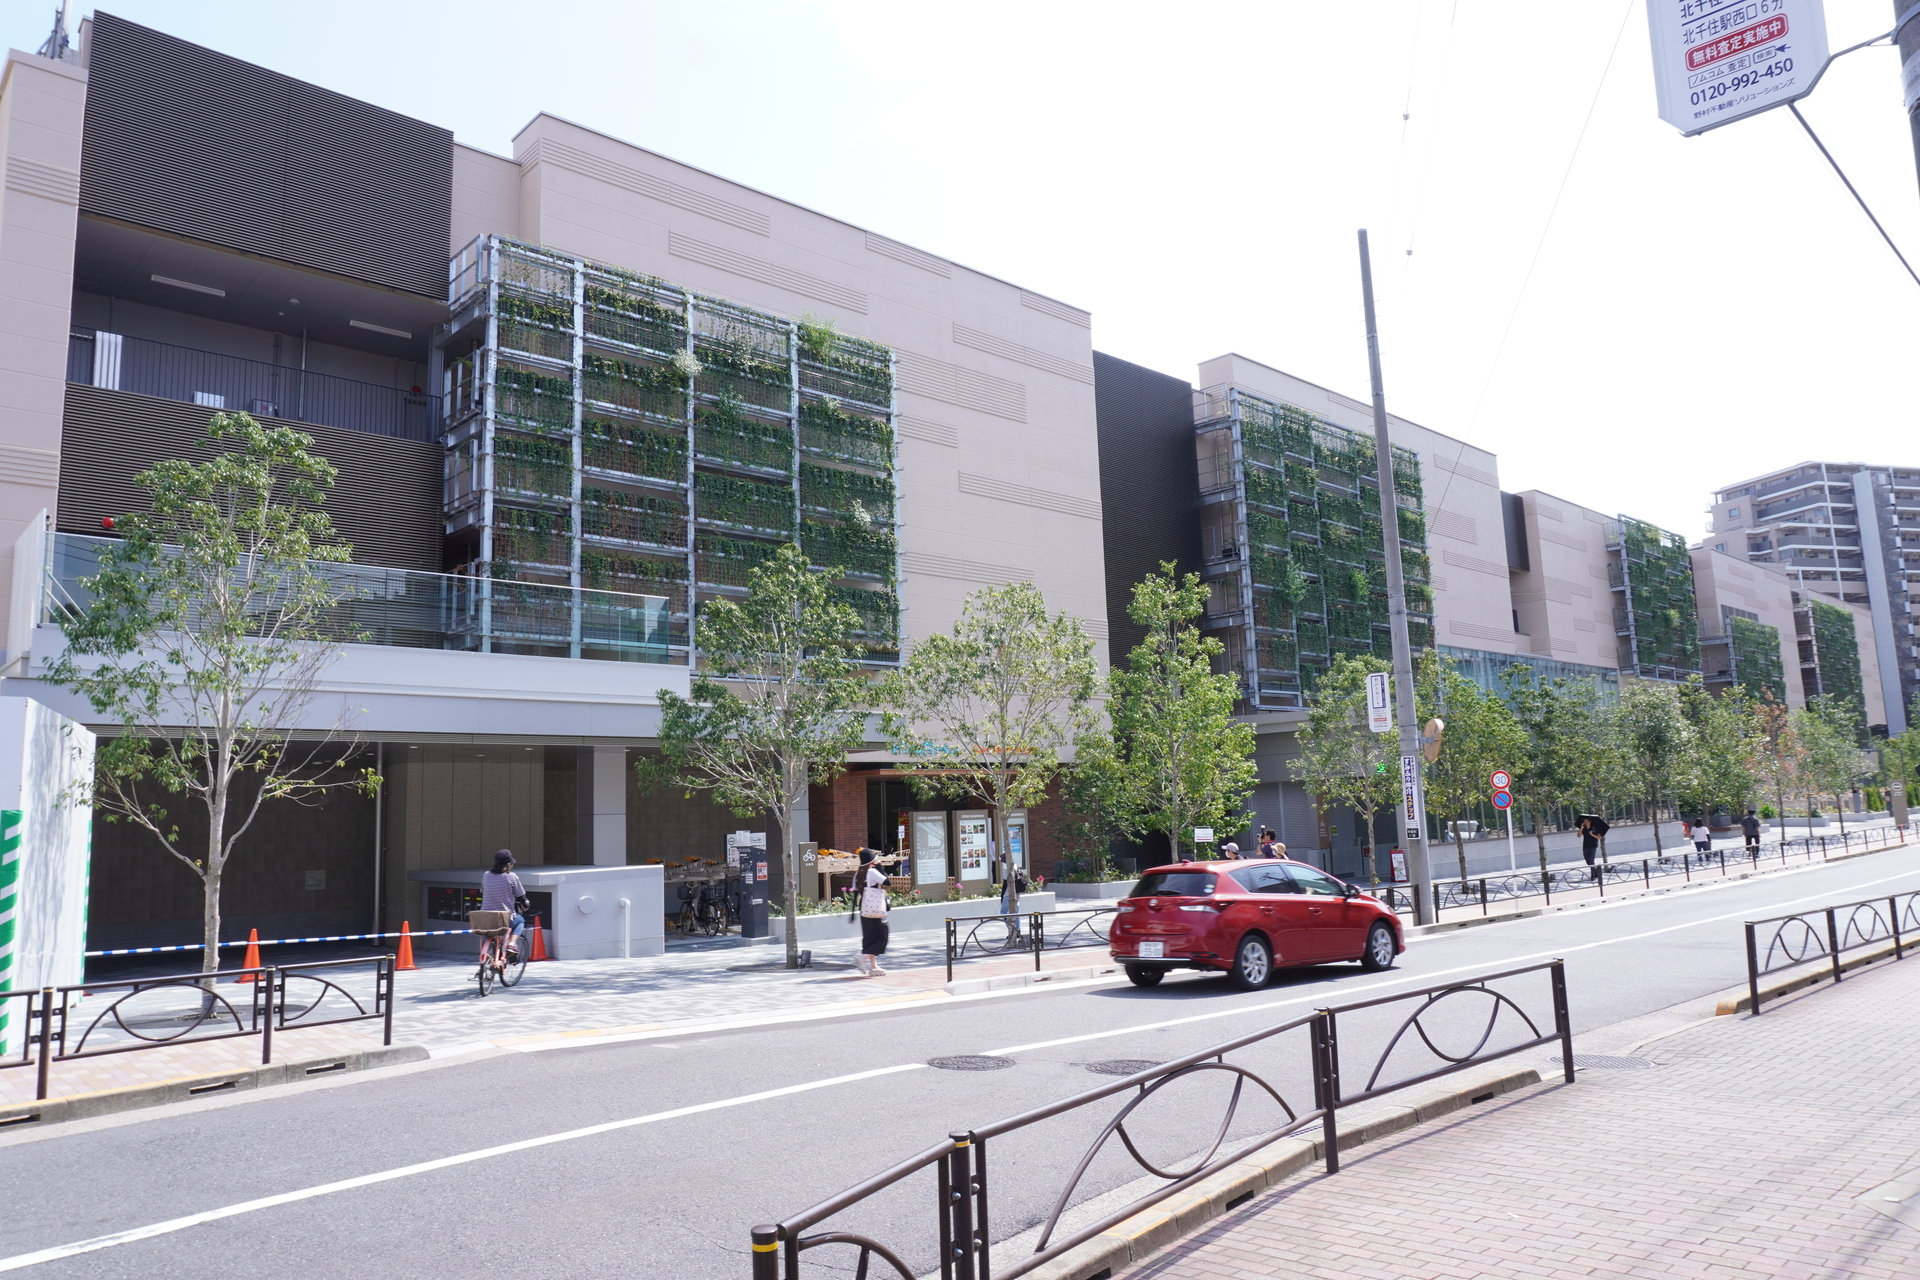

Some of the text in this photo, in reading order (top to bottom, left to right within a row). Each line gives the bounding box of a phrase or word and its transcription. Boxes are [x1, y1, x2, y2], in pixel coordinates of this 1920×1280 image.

[1692, 20, 1782, 66] 無料査定実施中
[1690, 58, 1794, 106] 0120-992-450
[1692, 68, 1725, 85] ノムコム
[1727, 58, 1747, 72] 査定
[1693, 77, 1795, 119] 野村不動産ソリューションズ
[1495, 775, 1506, 785] 30
